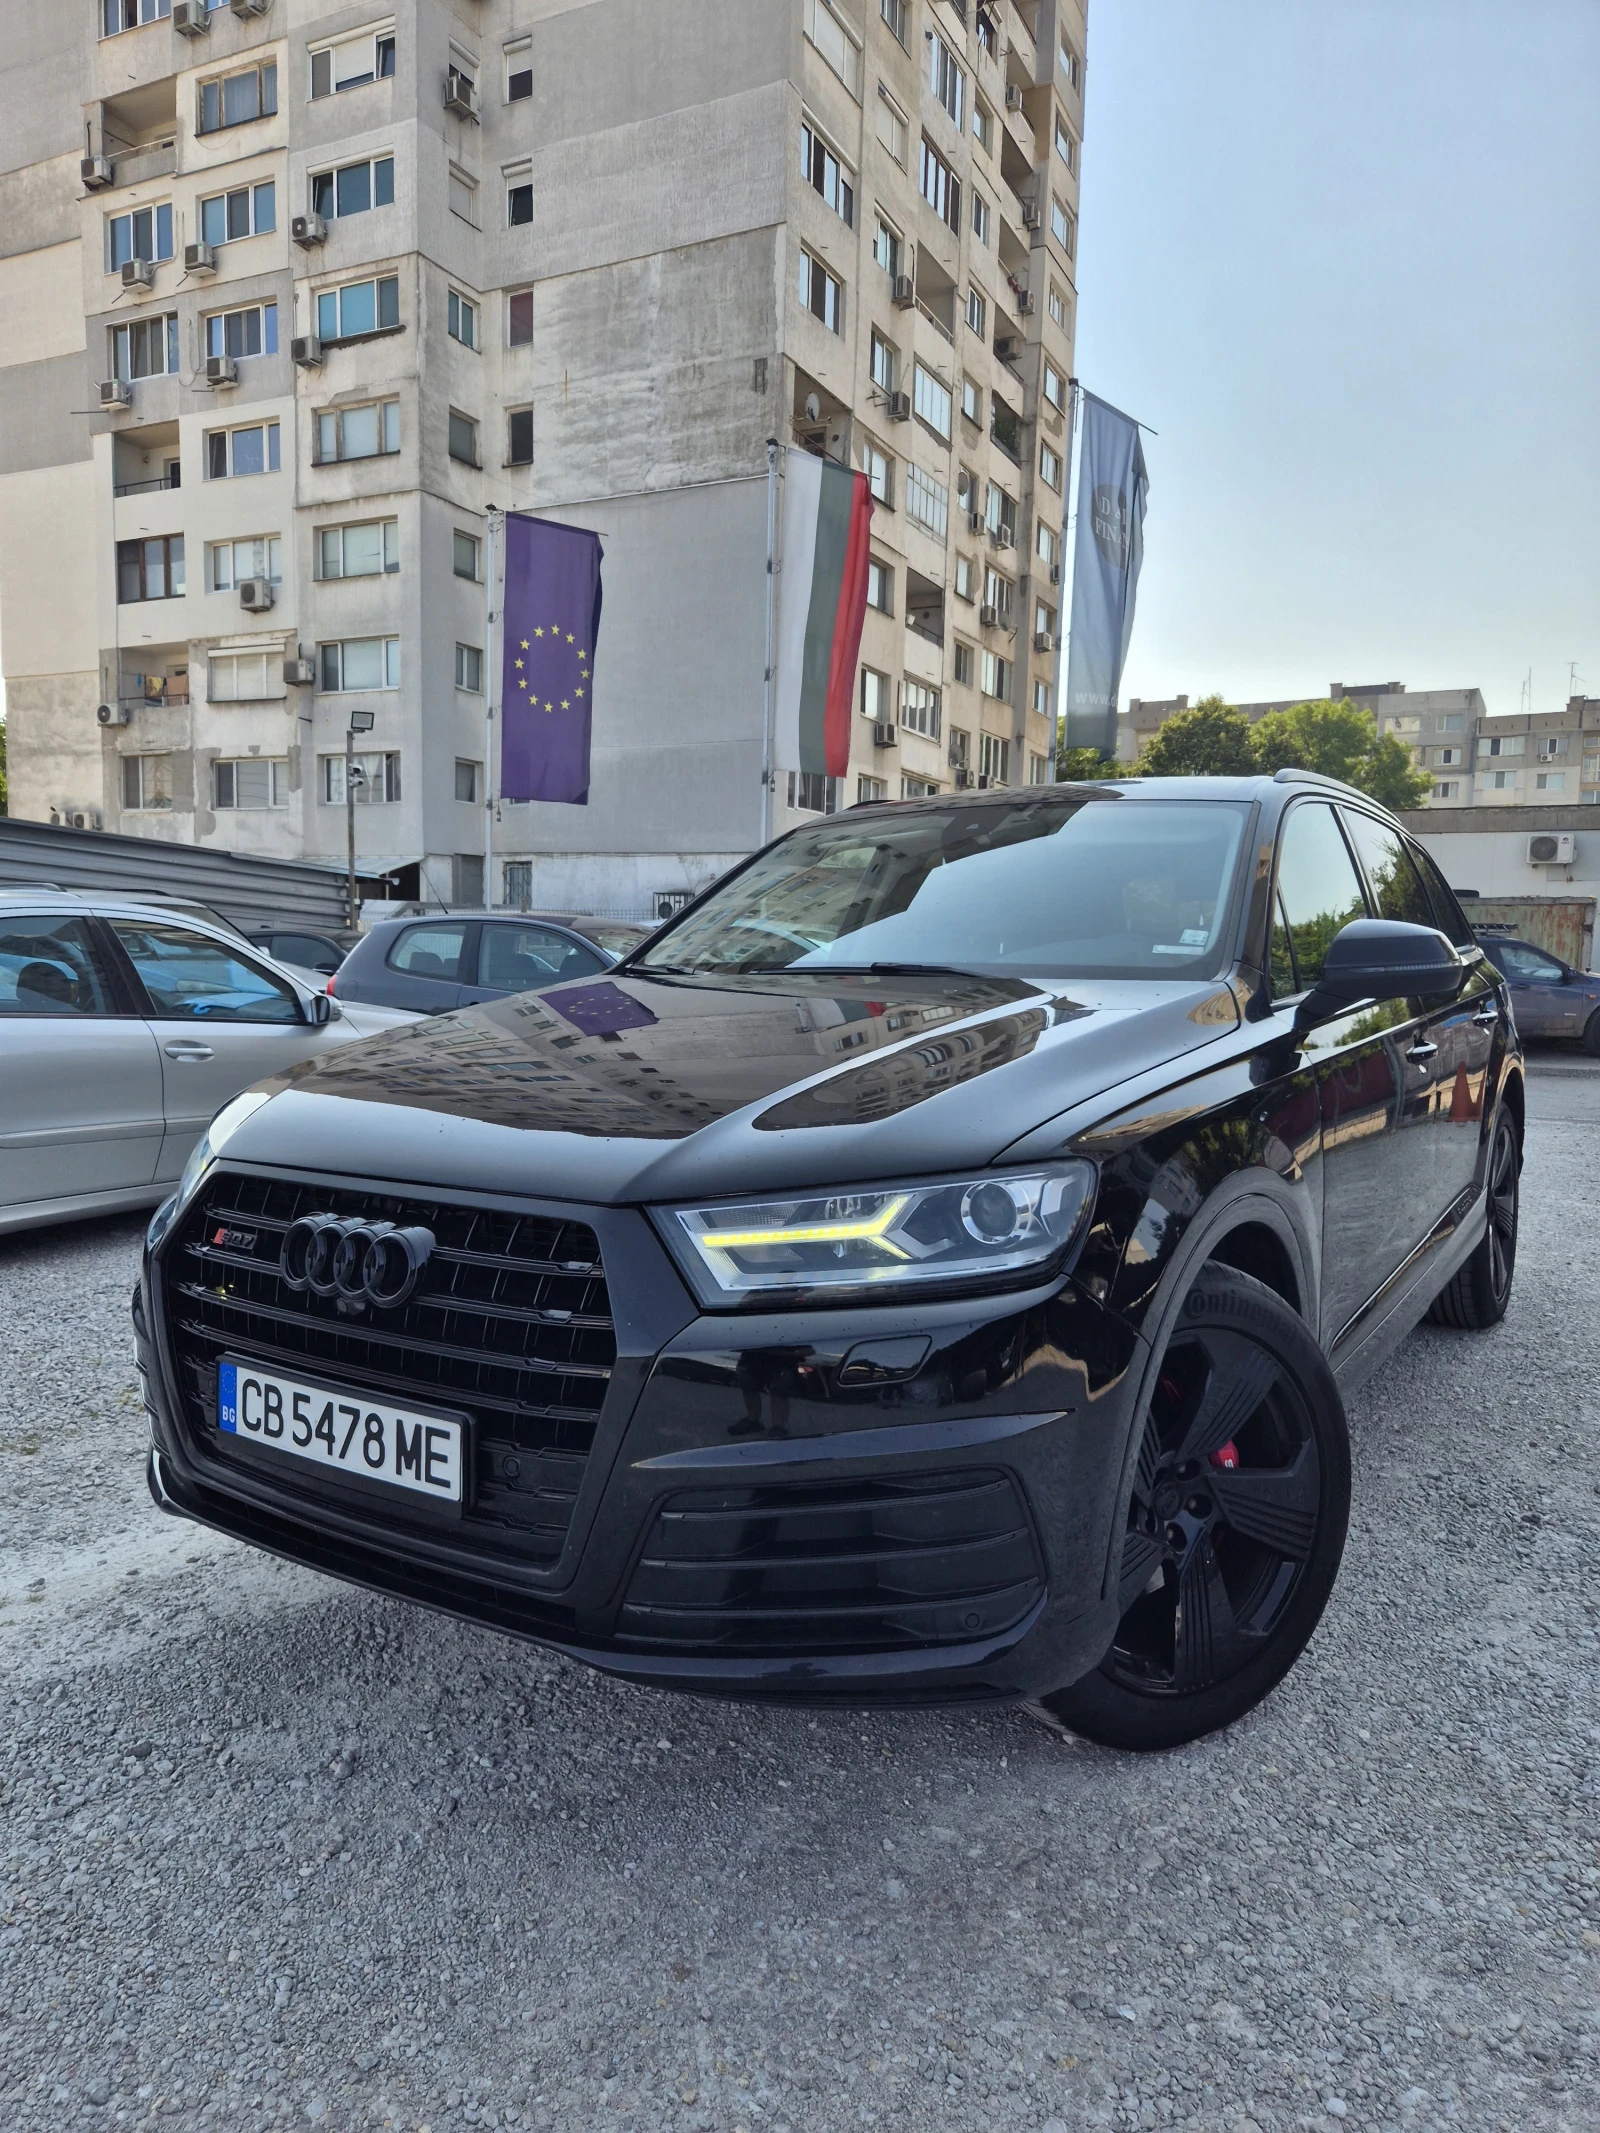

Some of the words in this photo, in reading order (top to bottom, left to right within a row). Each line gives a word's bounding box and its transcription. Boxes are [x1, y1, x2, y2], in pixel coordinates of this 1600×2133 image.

[1101, 496, 1111, 515] D
[221, 1231, 255, 1248] SQ7
[222, 1405, 236, 1423] BG
[242, 1378, 284, 1439] CB
[292, 1391, 386, 1469] 5478
[396, 1419, 451, 1489] ME
